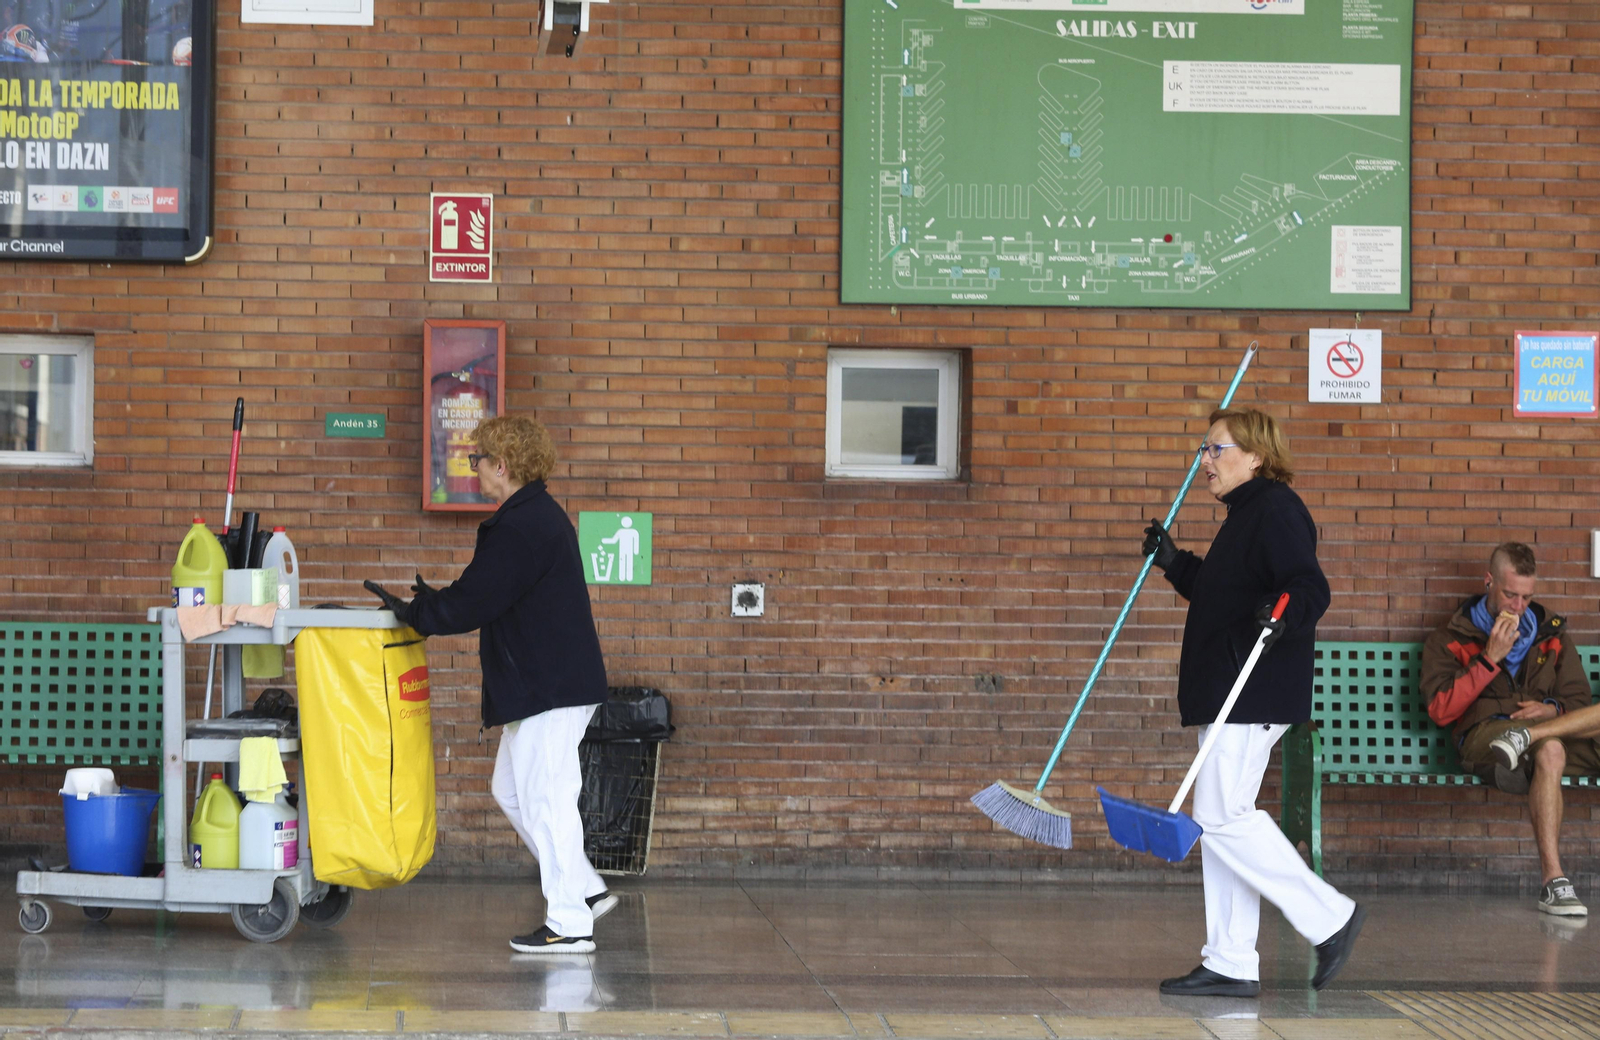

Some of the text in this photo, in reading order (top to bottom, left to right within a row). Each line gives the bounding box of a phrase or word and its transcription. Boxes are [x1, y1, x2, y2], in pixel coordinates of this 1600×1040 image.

[1056, 19, 1137, 38] SALIDAS
[1152, 21, 1198, 38] EXIT
[1173, 66, 1179, 74] E
[1169, 82, 1183, 91] UK
[29, 79, 53, 107] LA
[59, 80, 179, 110] TEMPORADA
[1173, 99, 1178, 107] F
[26, 141, 50, 169] EN
[57, 142, 109, 170] DAZN
[156, 197, 174, 205] UFC
[11, 240, 64, 252] Channel
[1221, 247, 1256, 263] RESTAURANTE
[435, 262, 486, 273] EXTINTOR
[1530, 340, 1539, 350] has
[1541, 340, 1562, 352] quedado
[1531, 356, 1584, 369] CARGA
[1537, 370, 1576, 386] AQUÍ
[1320, 380, 1370, 389] PROHIBIDO
[1328, 391, 1362, 399] FUMAR
[1523, 387, 1592, 403] TU MÓVIL
[438, 408, 483, 419] EN CASO DE
[333, 419, 378, 428] Andén 35
